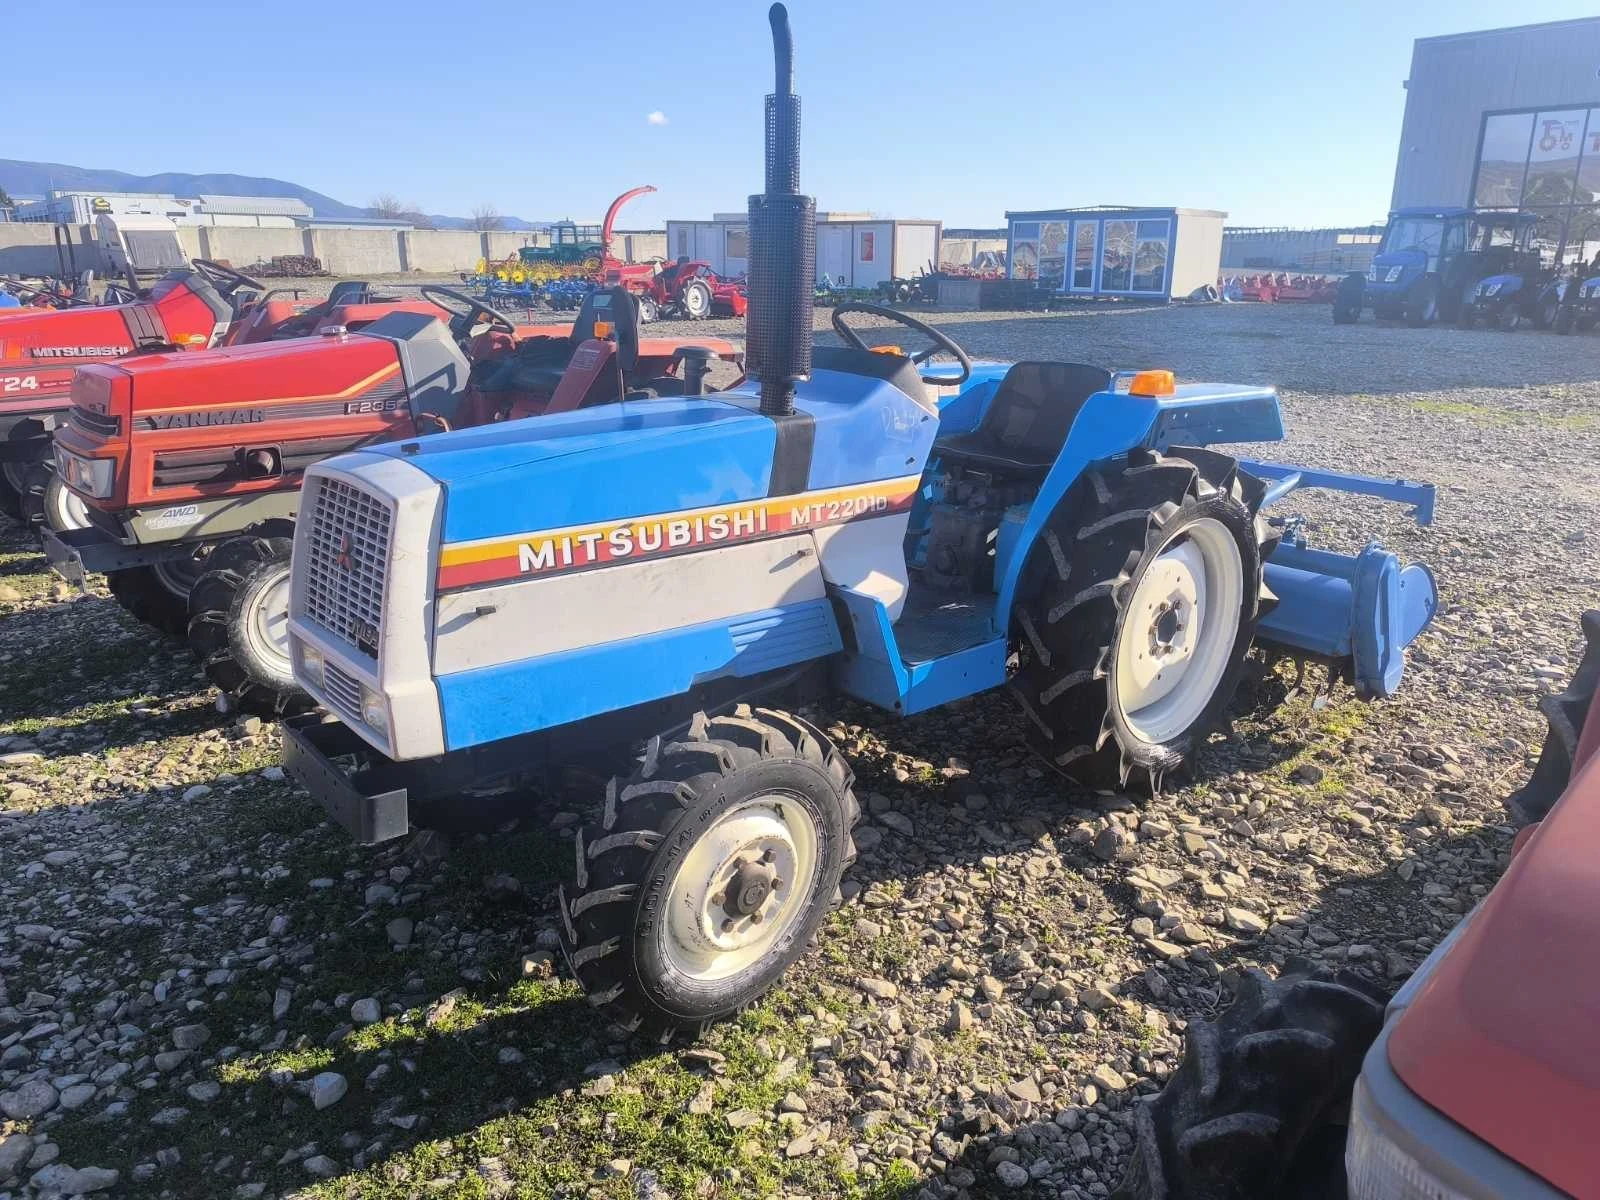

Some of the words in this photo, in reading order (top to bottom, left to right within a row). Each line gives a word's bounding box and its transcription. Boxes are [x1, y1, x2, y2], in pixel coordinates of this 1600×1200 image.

[31, 346, 129, 358] MITSUBISHI
[0, 375, 38, 391] 24
[147, 408, 265, 430] YANMAR
[518, 506, 768, 573] MITSUBISHI
[791, 495, 888, 526] MT2201D
